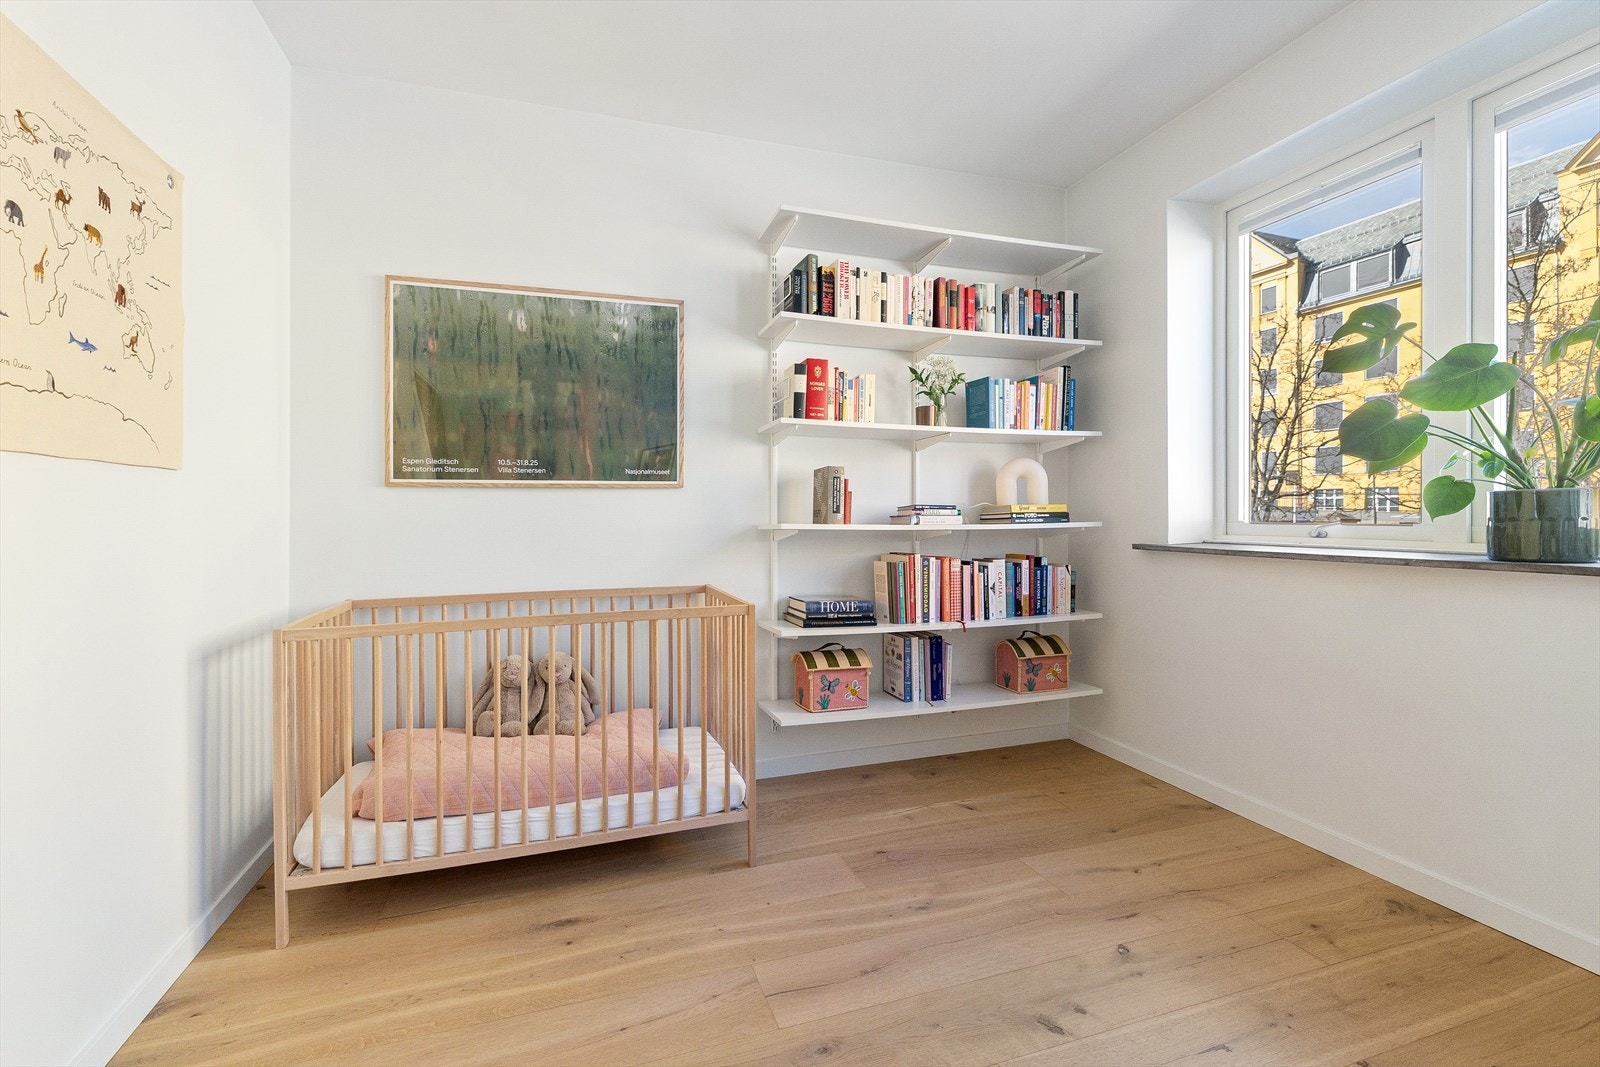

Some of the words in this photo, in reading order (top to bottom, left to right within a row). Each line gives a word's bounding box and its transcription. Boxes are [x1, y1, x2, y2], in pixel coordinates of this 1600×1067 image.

[72, 117, 89, 133] Ocean
[72, 279, 89, 292] Indian
[90, 288, 106, 300] Ocean
[12, 357, 33, 371] Ocean
[402, 457, 425, 466] Espen
[425, 457, 459, 465] Gleditsch
[402, 465, 443, 473] Sanatorium
[625, 468, 671, 476] Nasjonalmuseet
[820, 600, 859, 613] HOME
